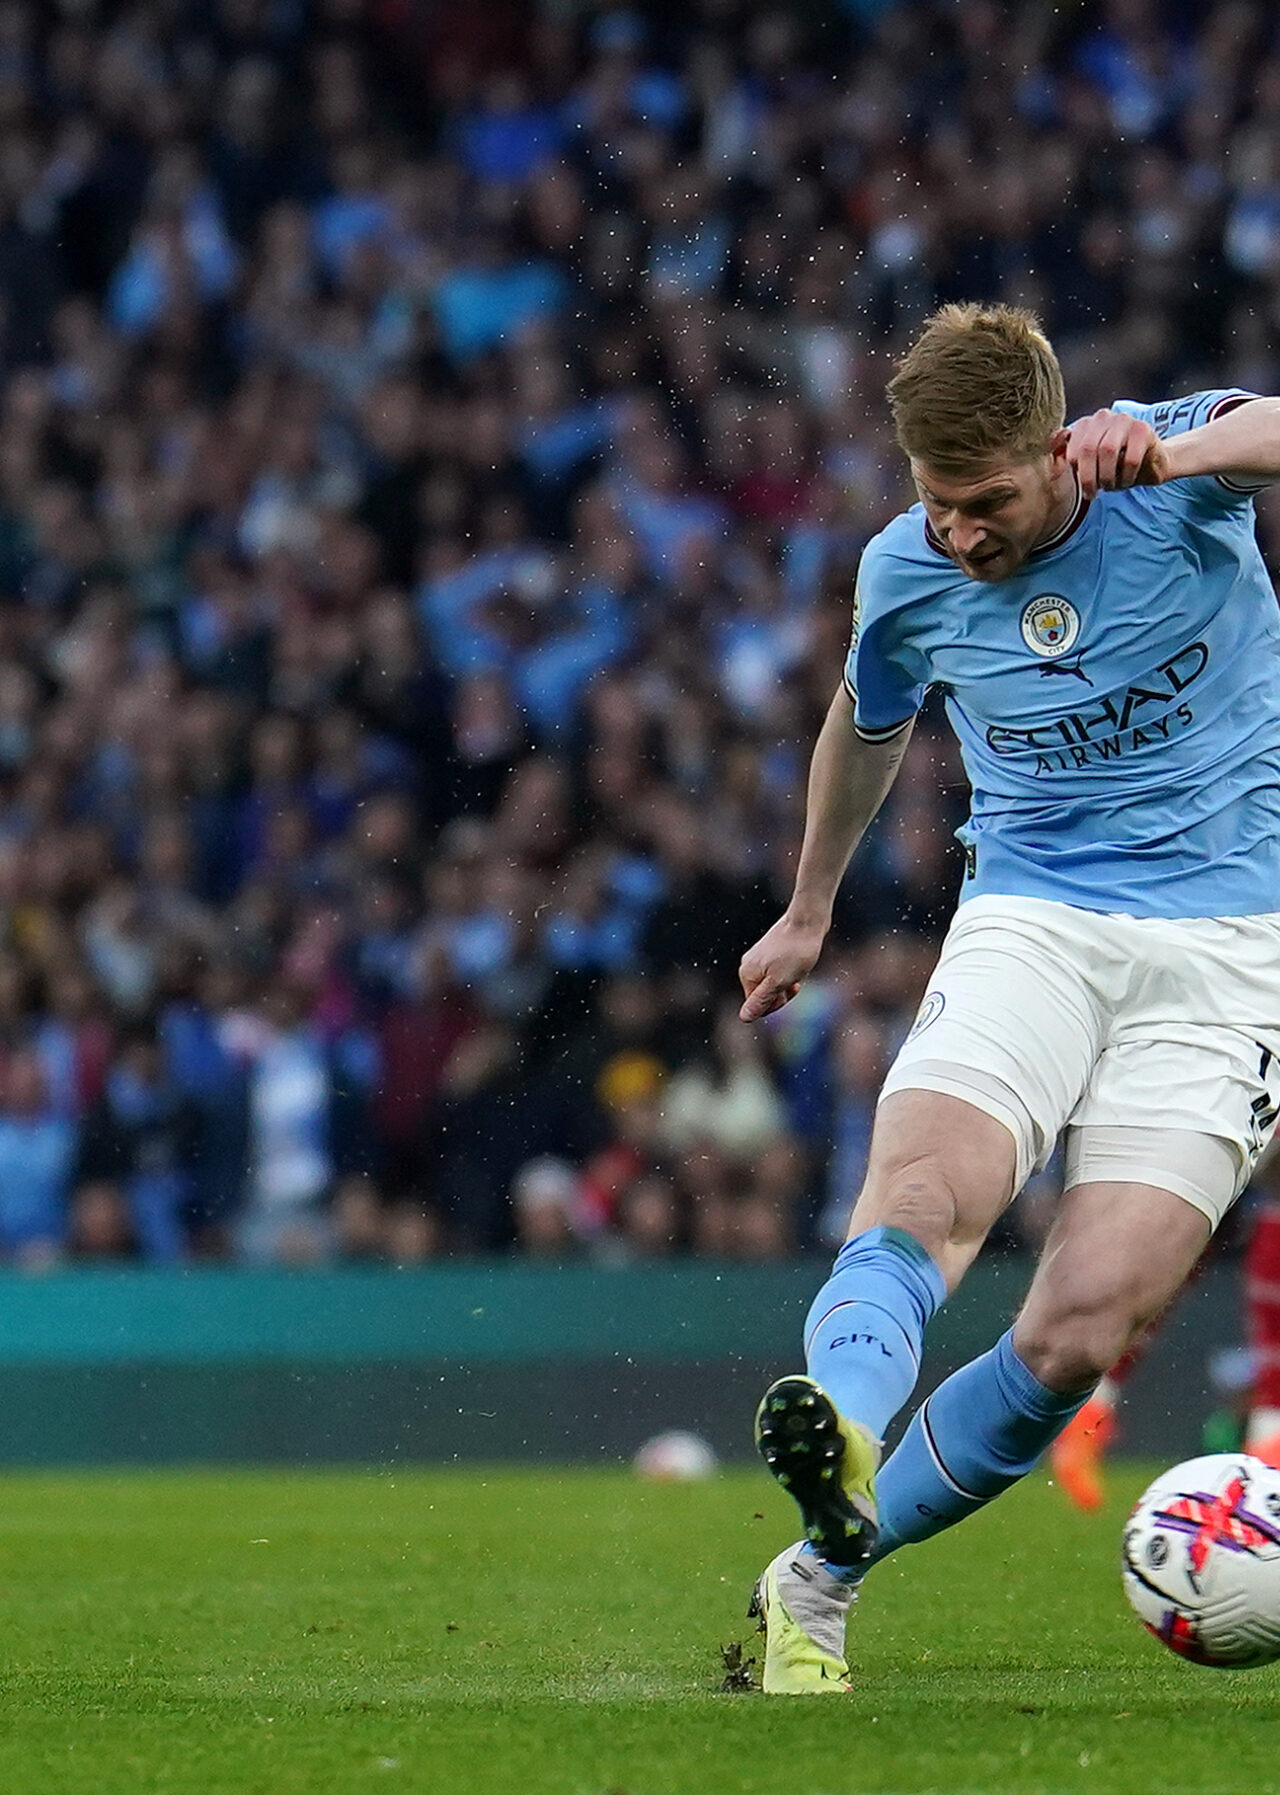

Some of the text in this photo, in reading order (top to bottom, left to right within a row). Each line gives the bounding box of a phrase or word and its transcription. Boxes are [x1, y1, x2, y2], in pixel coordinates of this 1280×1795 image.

[1048, 645, 1065, 655] CITY
[983, 641, 1209, 755] ETIHAD
[1034, 702, 1193, 776] AIRWAYS
[829, 1333, 893, 1358] CITY
